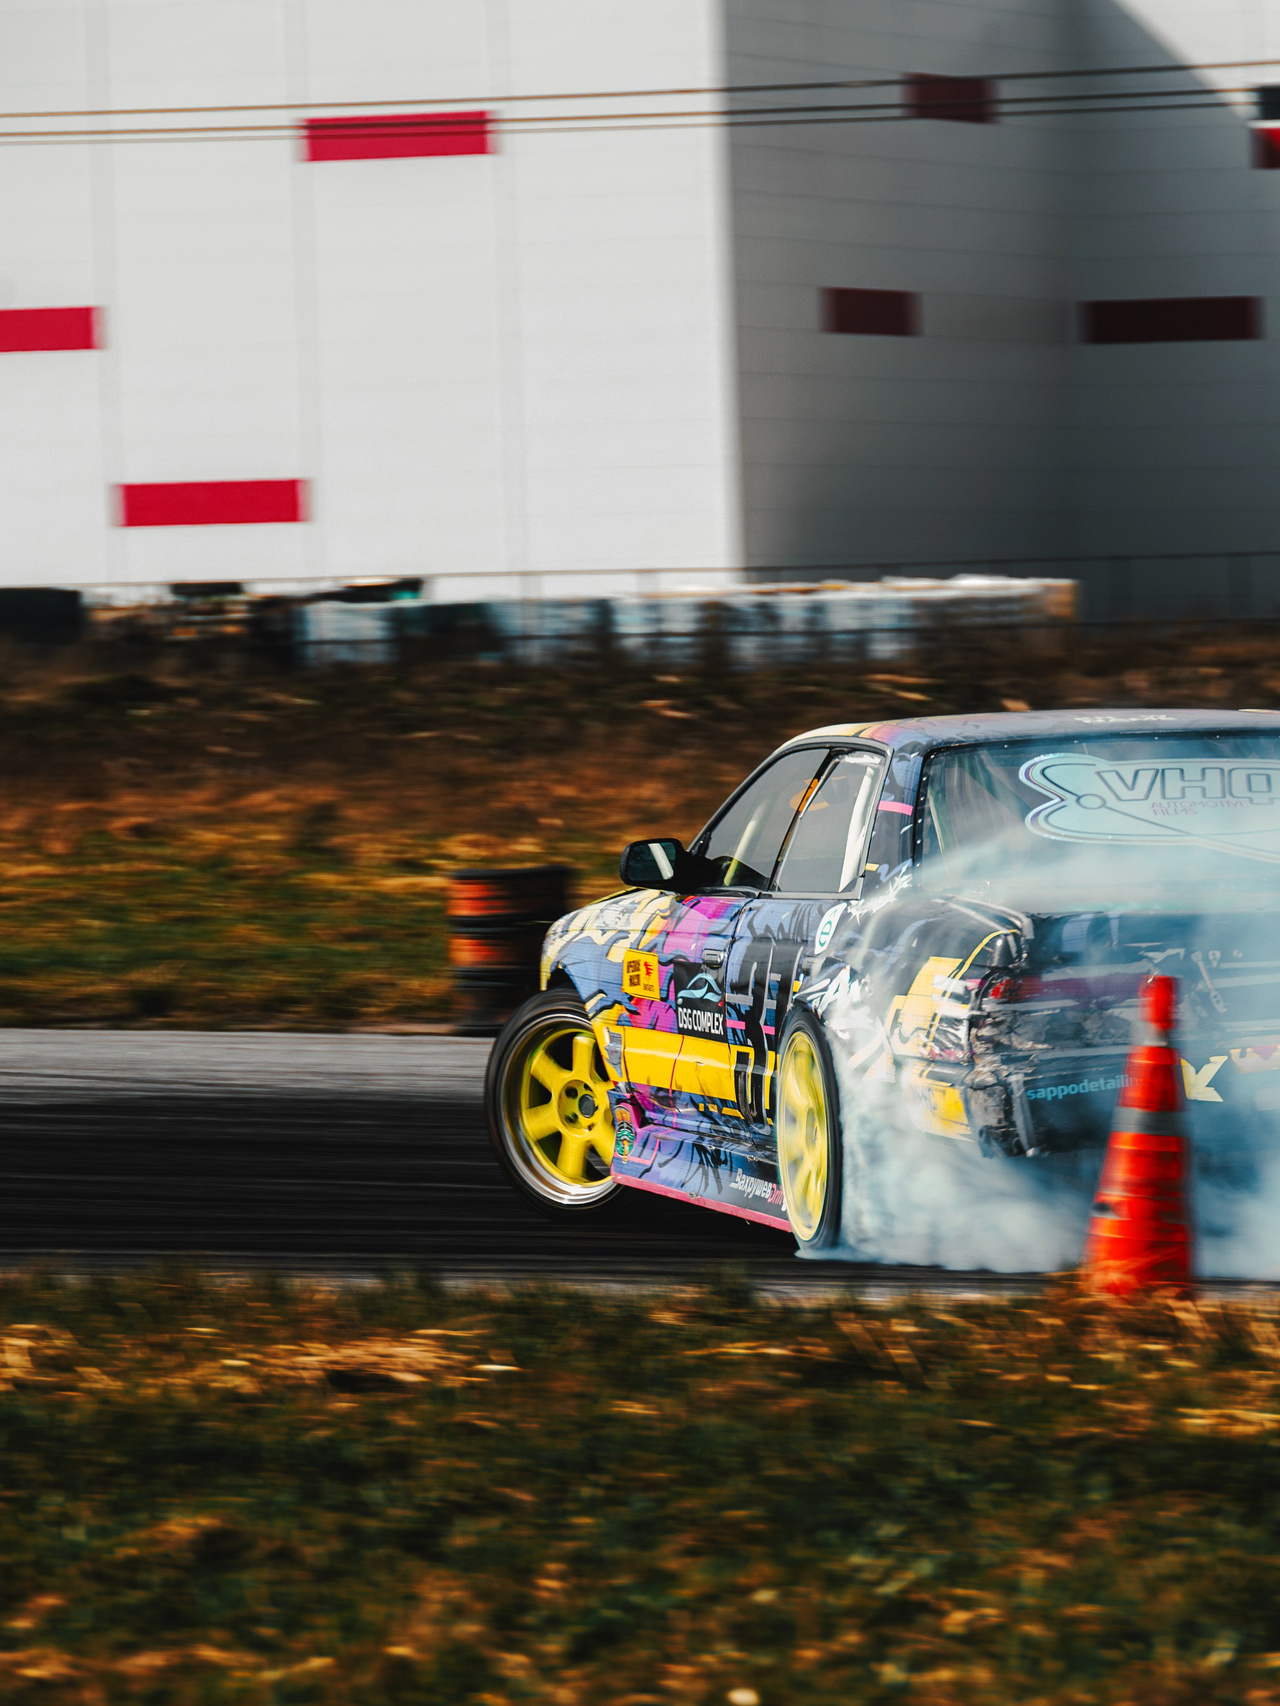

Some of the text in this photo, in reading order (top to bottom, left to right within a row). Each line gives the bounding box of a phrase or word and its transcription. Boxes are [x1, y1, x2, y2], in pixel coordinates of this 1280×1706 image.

[1150, 800, 1251, 810] AUTOMOTIVE
[1151, 808, 1198, 817] FILMS
[677, 1006, 724, 1036] DSG COMPLEX
[1026, 1074, 1139, 1101] sappodetailin
